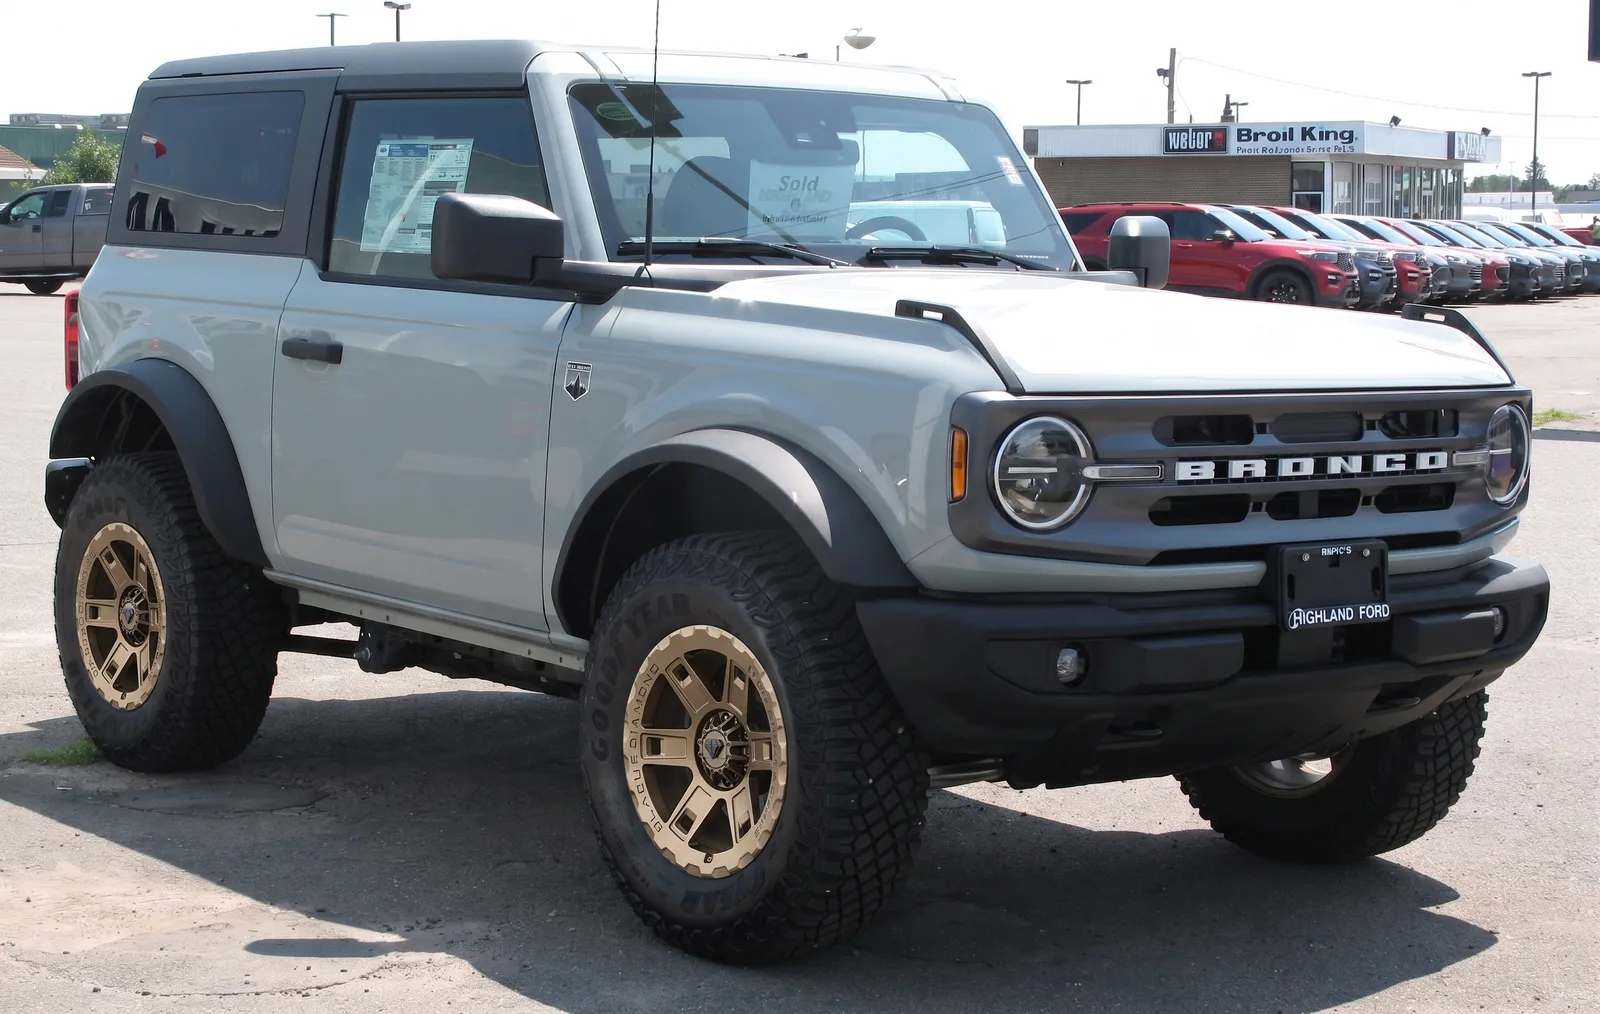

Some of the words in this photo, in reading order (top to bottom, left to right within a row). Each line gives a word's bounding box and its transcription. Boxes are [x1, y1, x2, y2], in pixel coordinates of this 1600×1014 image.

[1236, 126, 1294, 142] Broil
[778, 175, 820, 191] Sold
[1175, 451, 1448, 480] BRONCO
[1288, 608, 1354, 629] HIGHLAND
[1359, 604, 1390, 619] FORD
